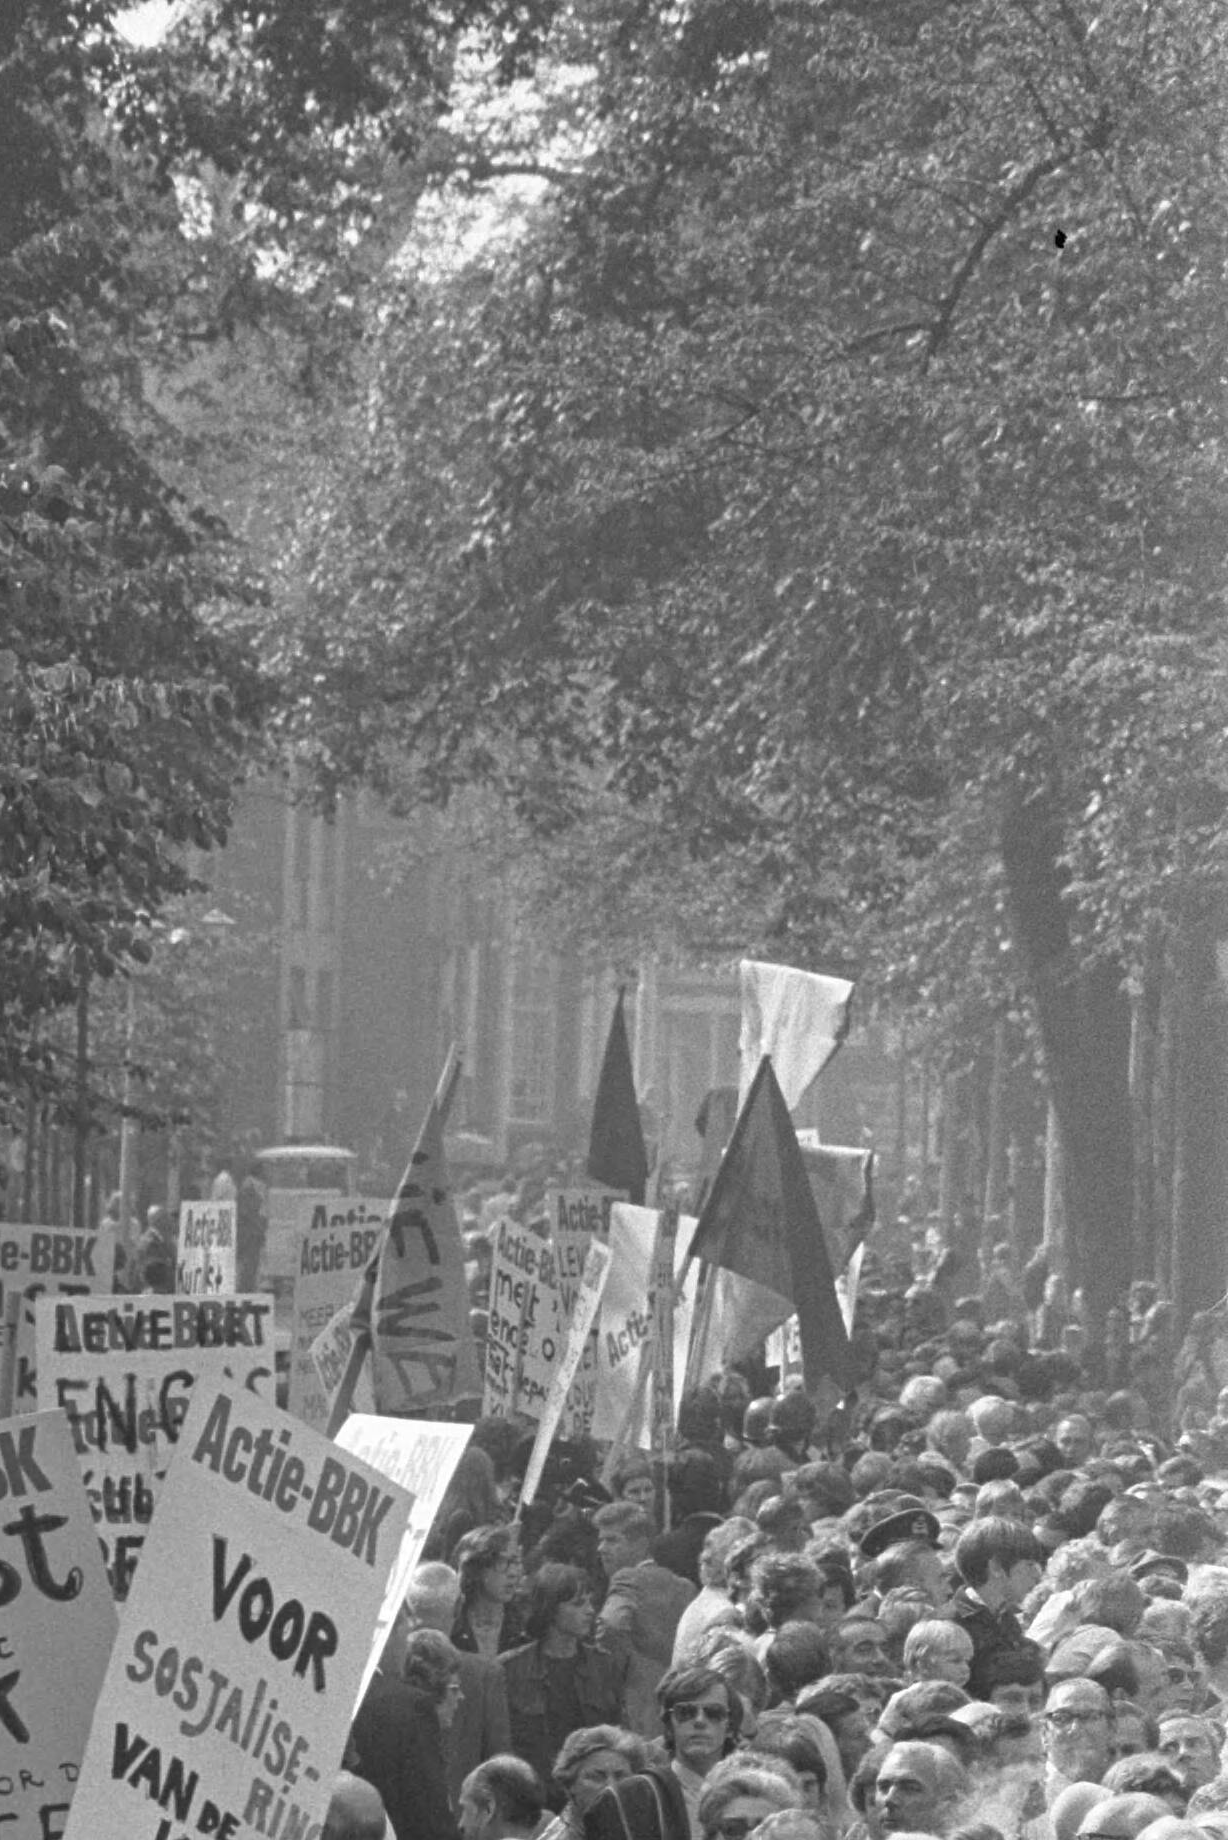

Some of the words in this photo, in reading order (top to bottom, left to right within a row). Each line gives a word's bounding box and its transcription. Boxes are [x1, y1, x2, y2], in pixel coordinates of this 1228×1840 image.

[192, 1393, 396, 1566] Actie-BBK
[212, 1532, 338, 1694] VOOR
[112, 1723, 199, 1823] VAN
